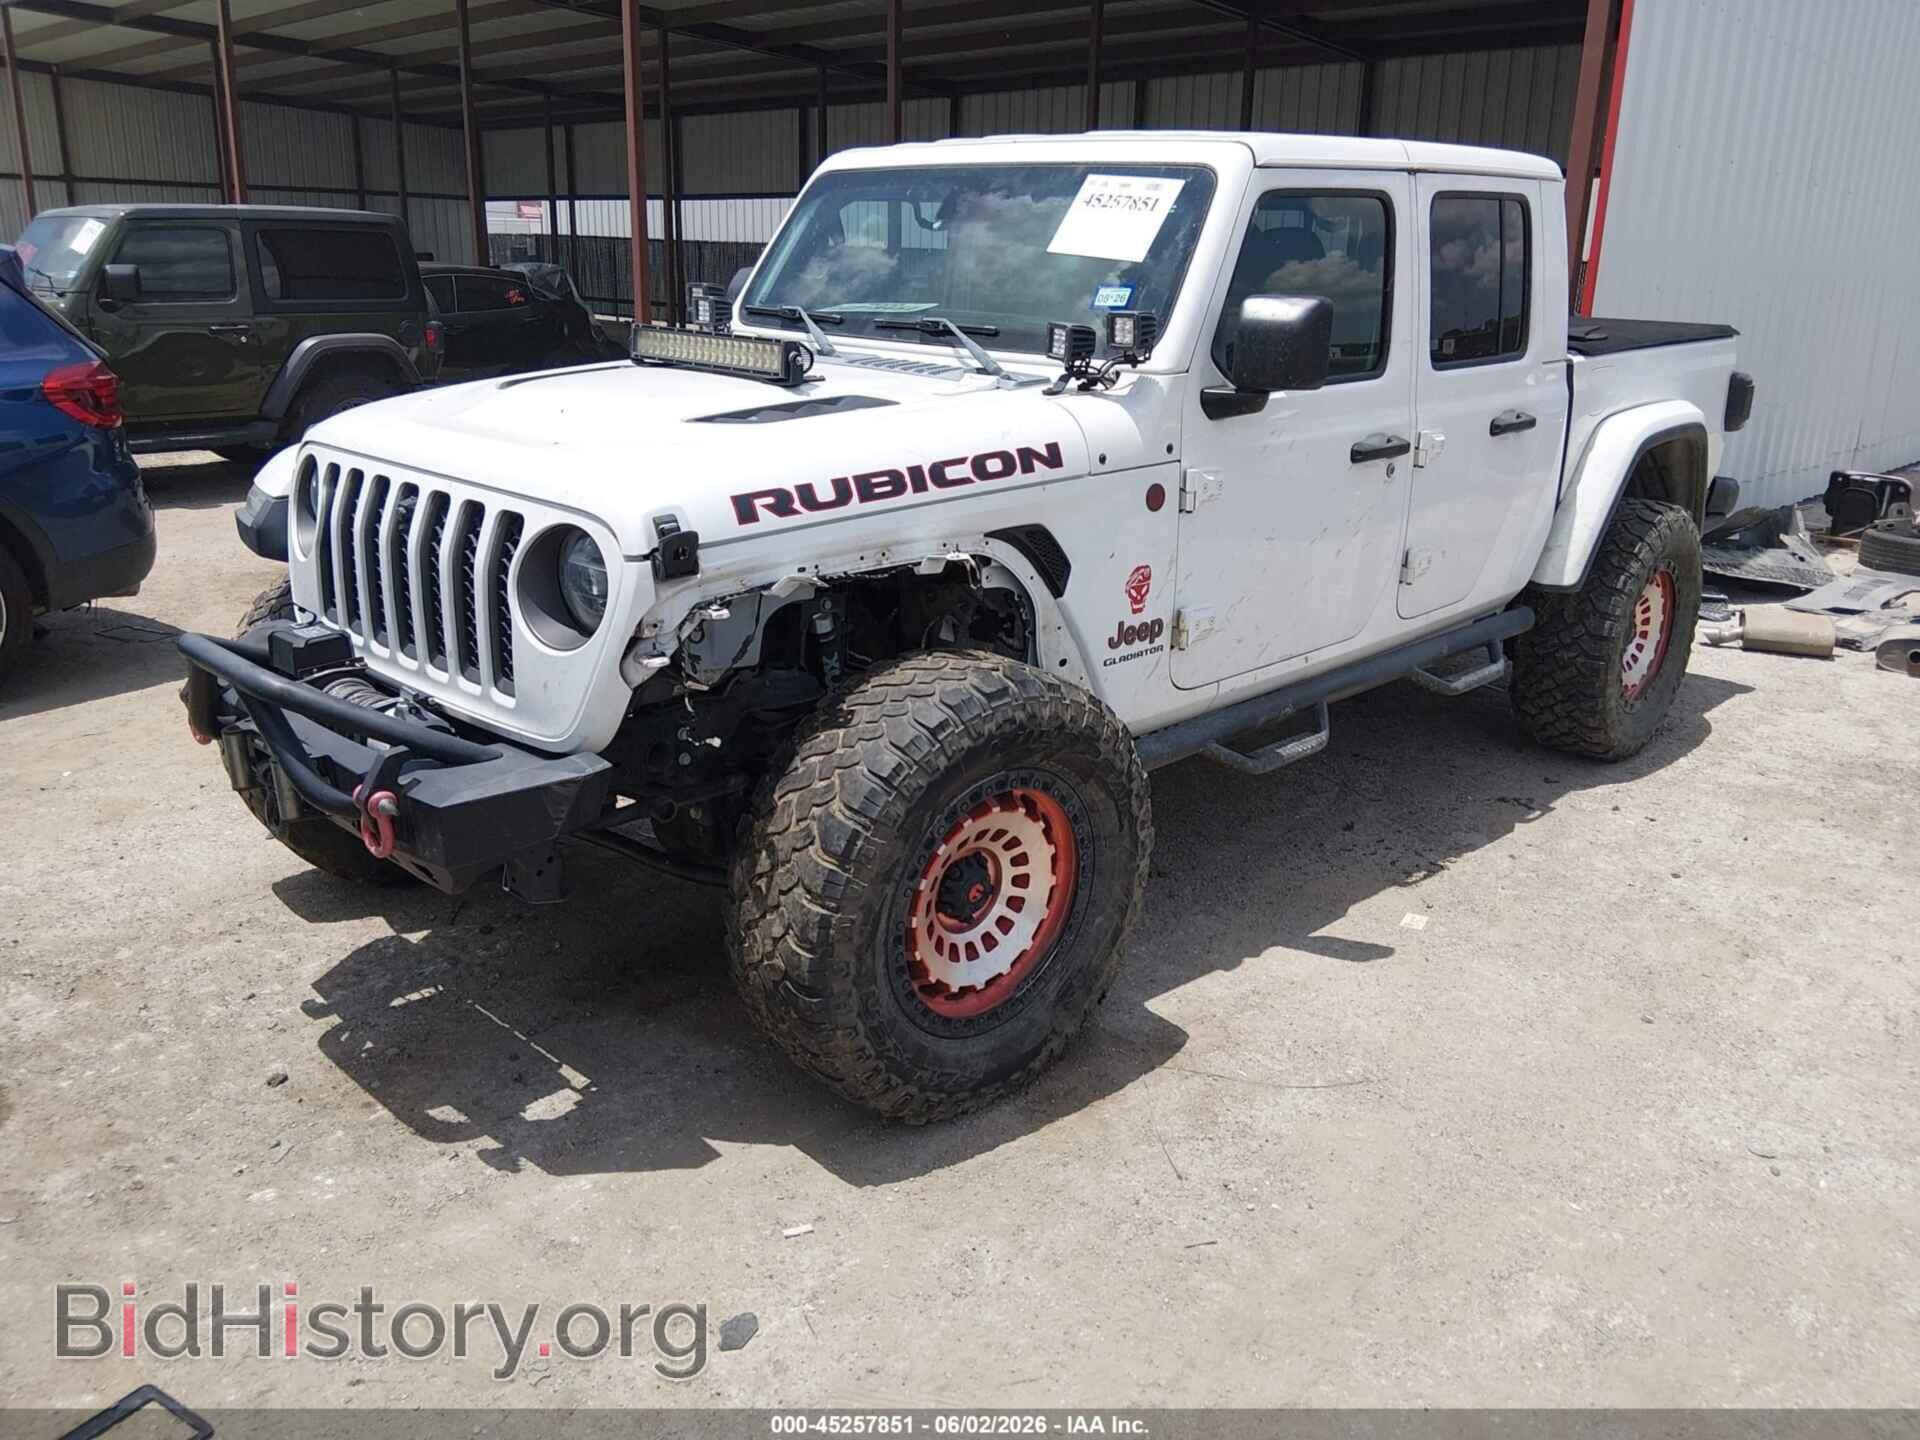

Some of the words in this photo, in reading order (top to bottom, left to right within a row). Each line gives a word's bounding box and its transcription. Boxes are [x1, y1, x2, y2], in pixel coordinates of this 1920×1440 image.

[1083, 193, 1160, 212] 45257851
[730, 441, 1064, 526] RUBICON
[1107, 617, 1164, 650] Jeep
[1103, 644, 1165, 667] GLADIATOR
